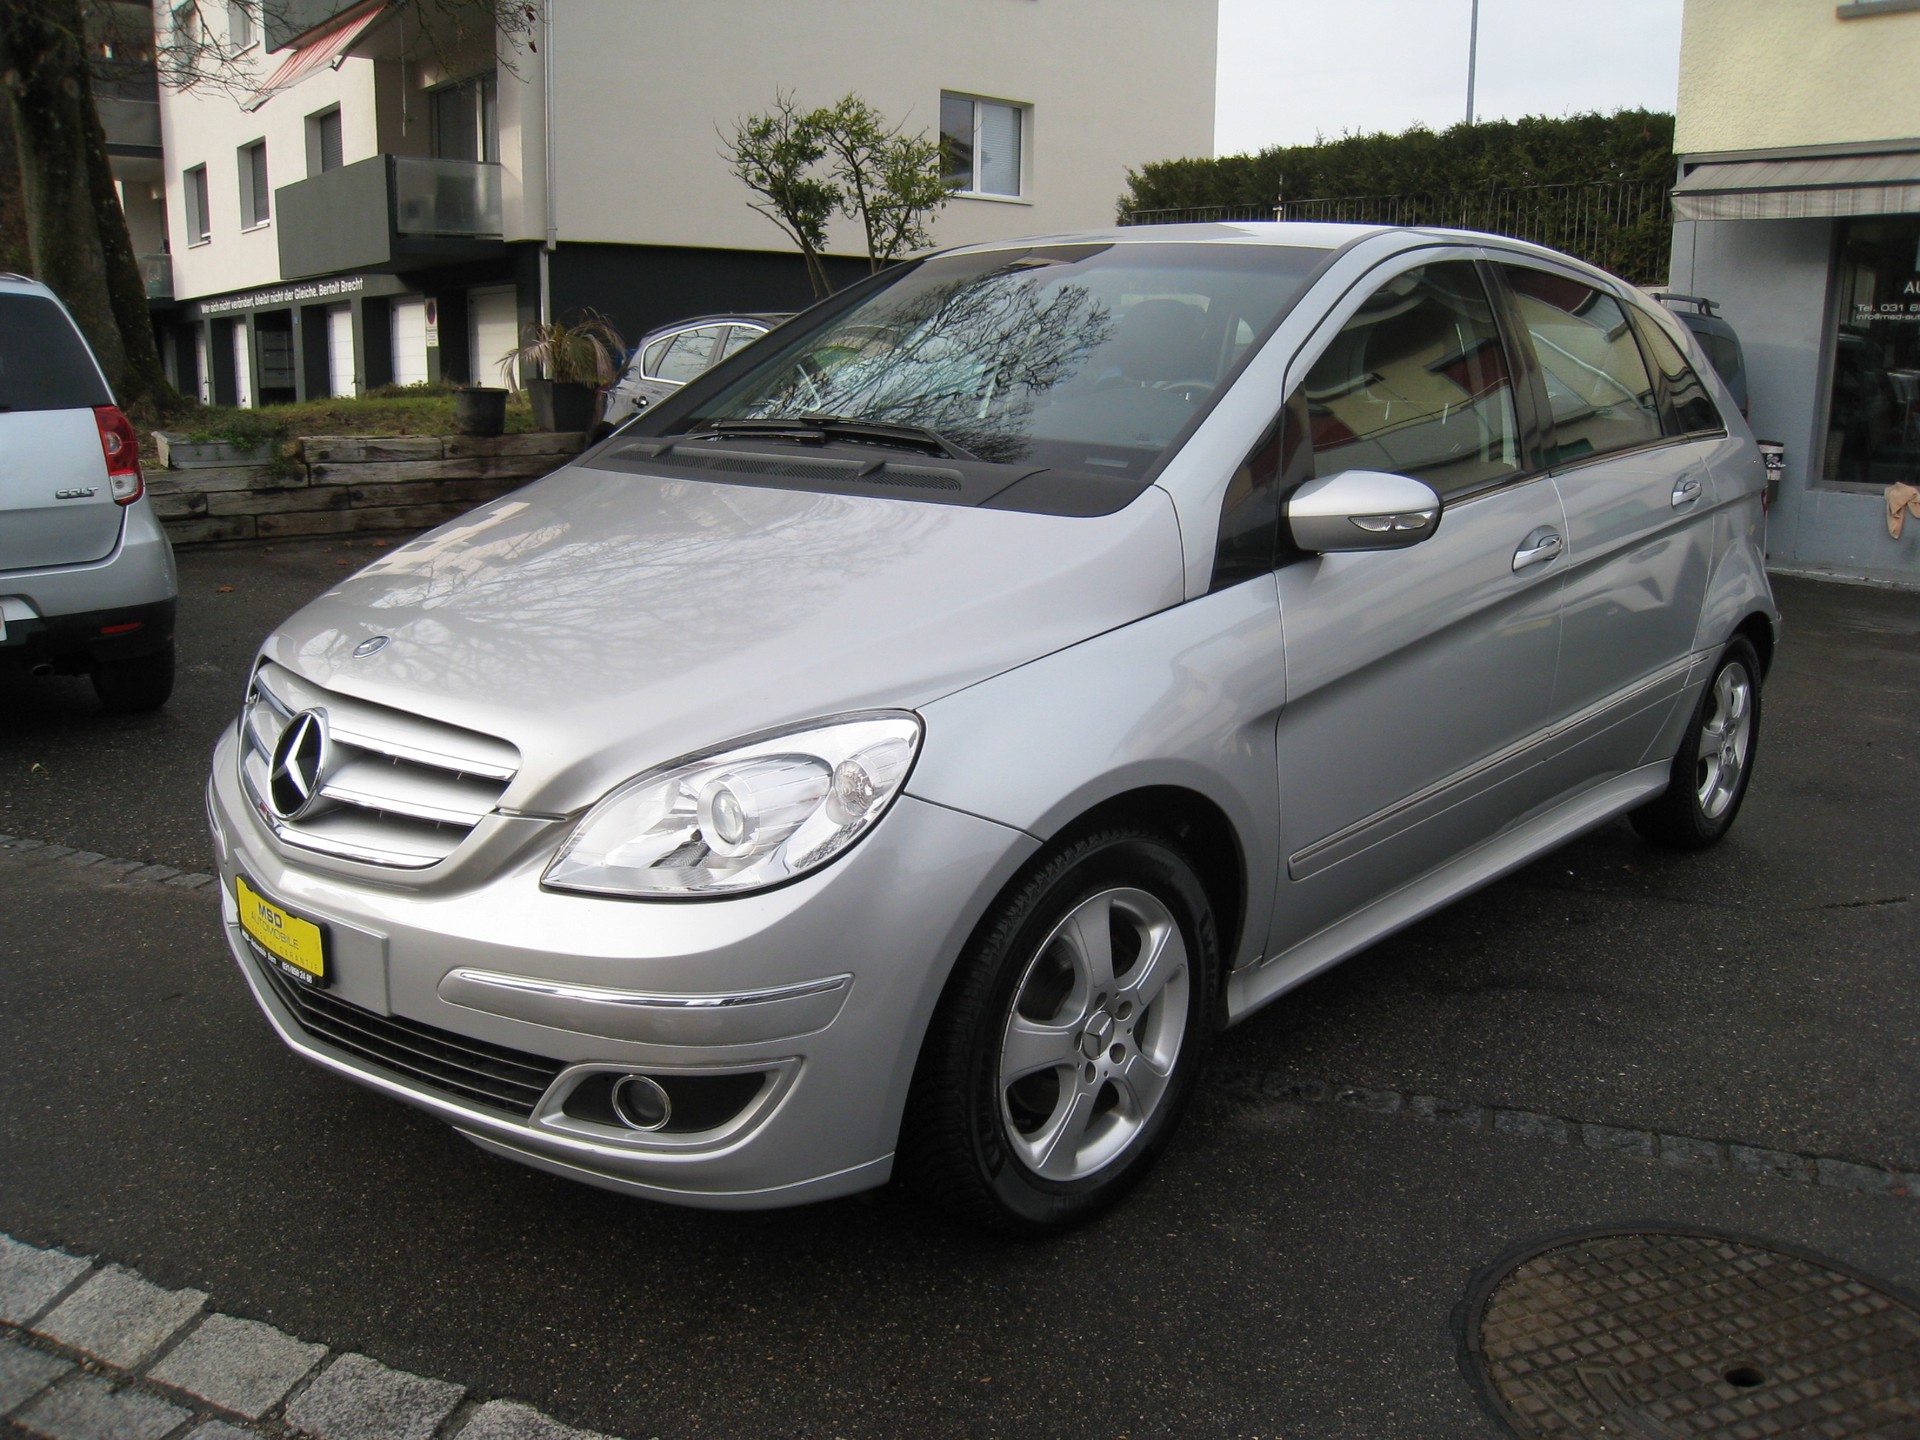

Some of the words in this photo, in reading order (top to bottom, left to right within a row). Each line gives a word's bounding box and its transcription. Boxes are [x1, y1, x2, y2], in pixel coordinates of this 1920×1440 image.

[210, 302, 220, 313] sich
[220, 300, 231, 312] nicht
[255, 293, 269, 306] bleibt
[270, 290, 284, 304] nicht
[284, 289, 294, 301] der
[294, 286, 318, 300] Gleiche.
[319, 281, 340, 296] Bertolt
[341, 277, 363, 293] Brecht
[1857, 303, 1876, 312] Tel.
[1880, 303, 1904, 312] 031
[55, 487, 99, 499] COLT
[258, 902, 283, 928] MSD
[251, 911, 299, 950] AUTOMOBILE
